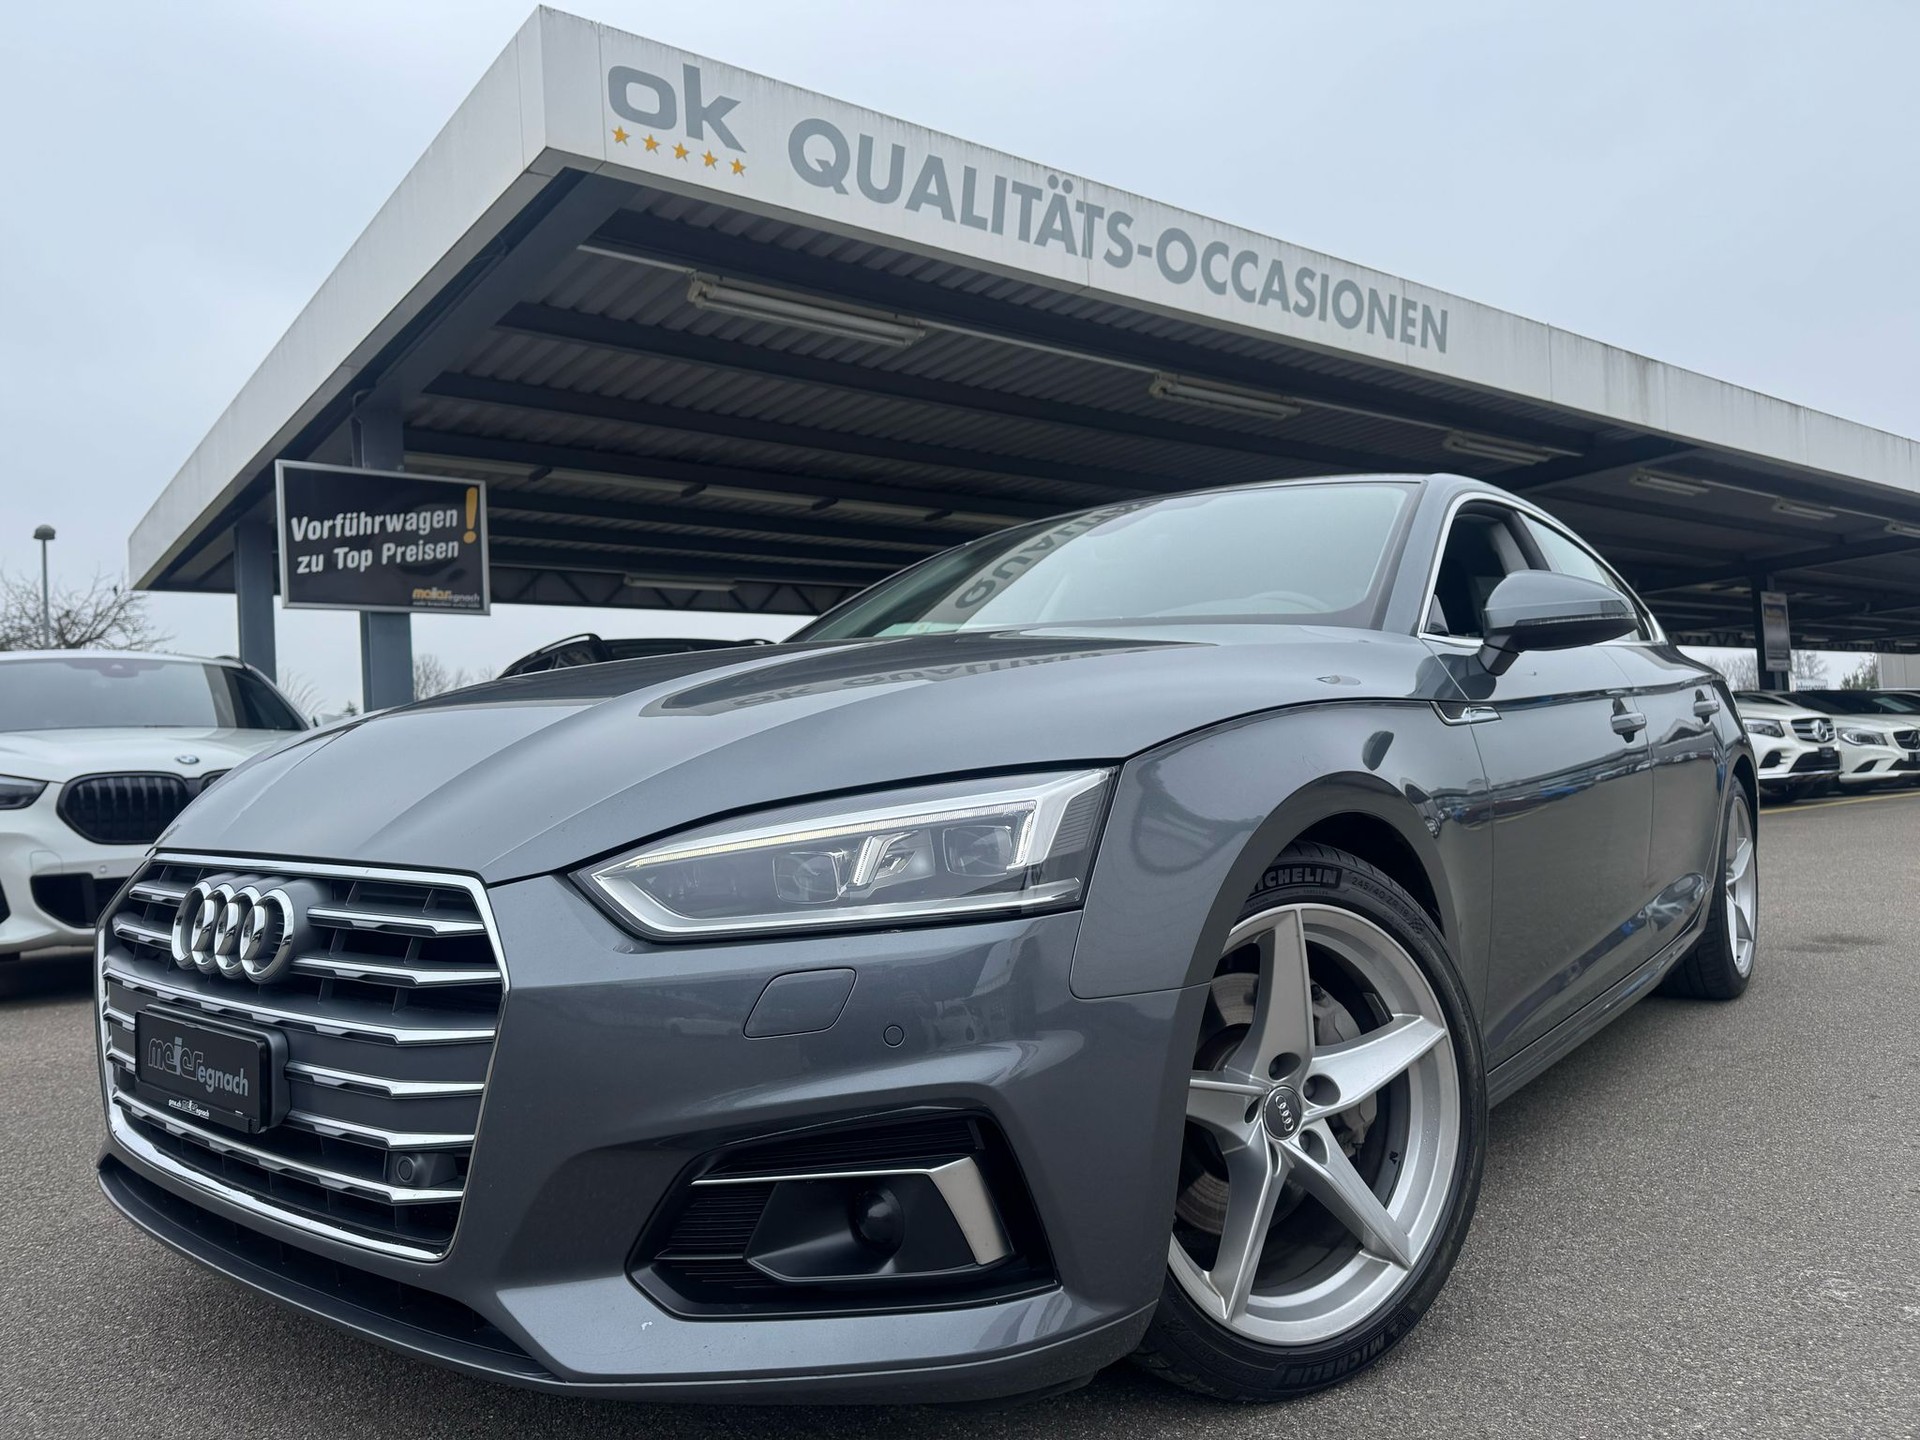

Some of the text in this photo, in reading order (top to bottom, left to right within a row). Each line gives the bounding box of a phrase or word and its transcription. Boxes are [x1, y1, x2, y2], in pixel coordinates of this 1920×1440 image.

[608, 63, 1449, 354] ok QUALITÄTS-OCCASIONEN
[290, 509, 458, 542] Vorführwagen
[296, 540, 459, 574] zu Top Preisen
[1254, 867, 1338, 892] ICHELIN
[197, 1067, 249, 1097] egnach
